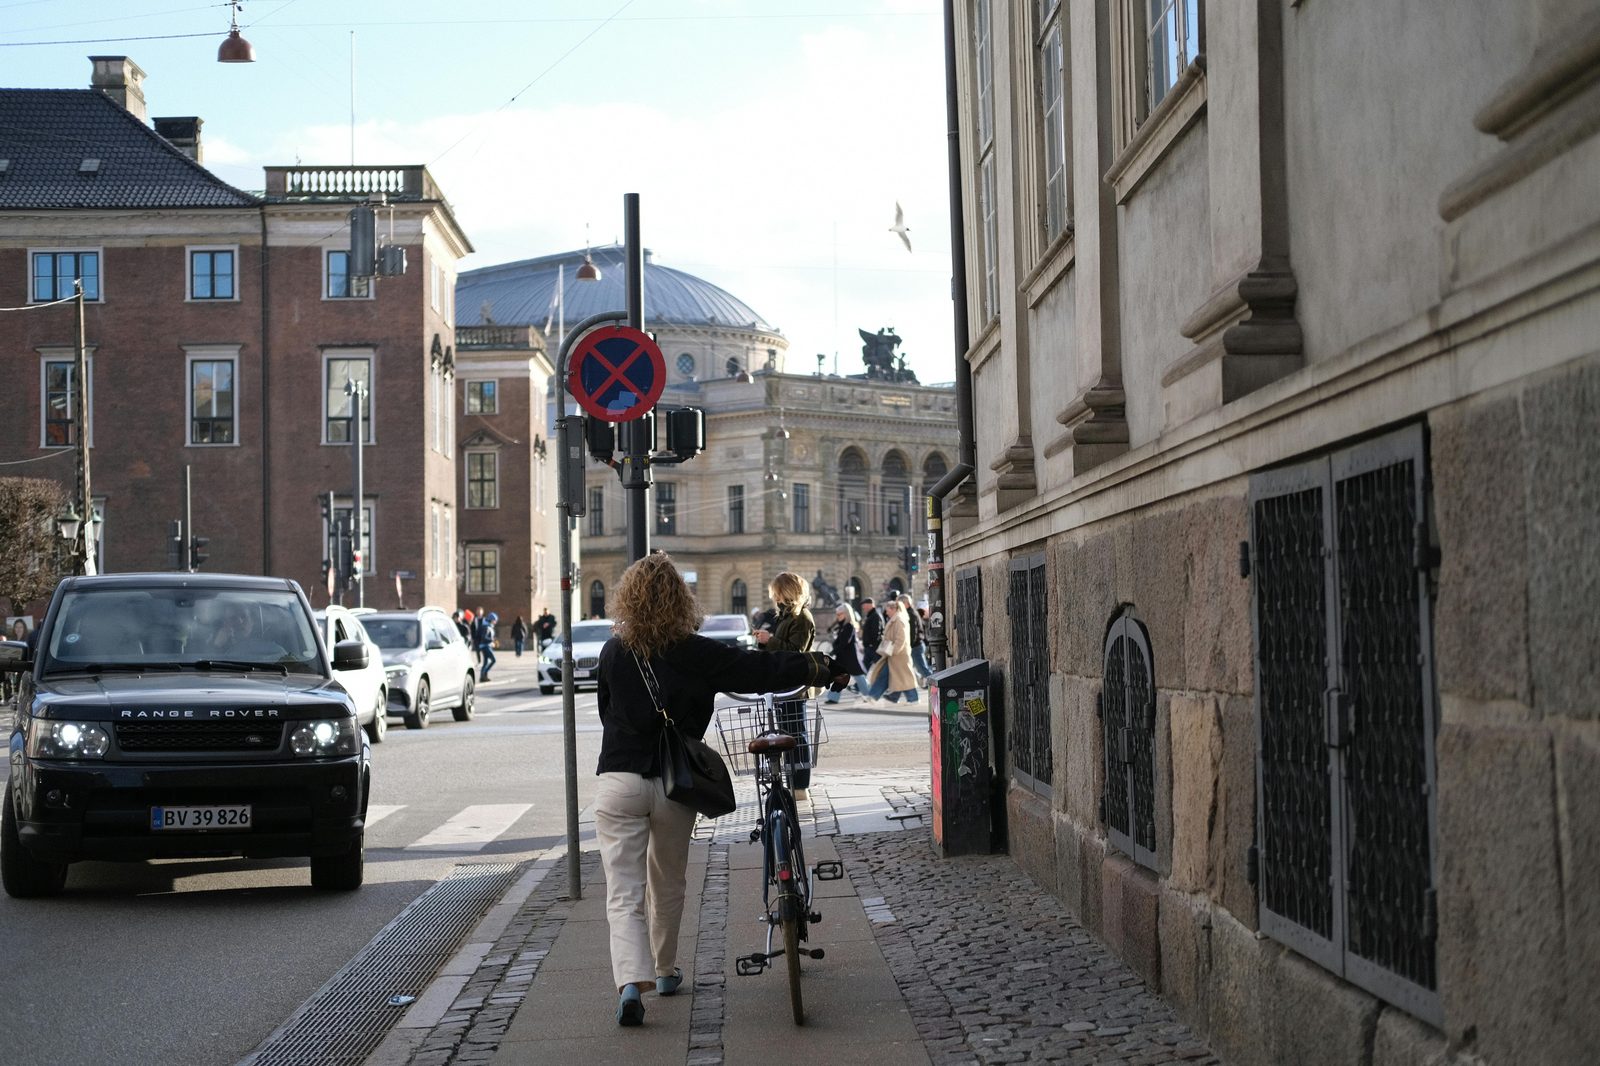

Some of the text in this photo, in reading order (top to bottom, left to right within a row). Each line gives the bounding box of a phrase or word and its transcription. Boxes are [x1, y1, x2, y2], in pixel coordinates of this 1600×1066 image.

[121, 709, 279, 718] RANGE ROVER
[164, 808, 249, 826] BV 39 826
